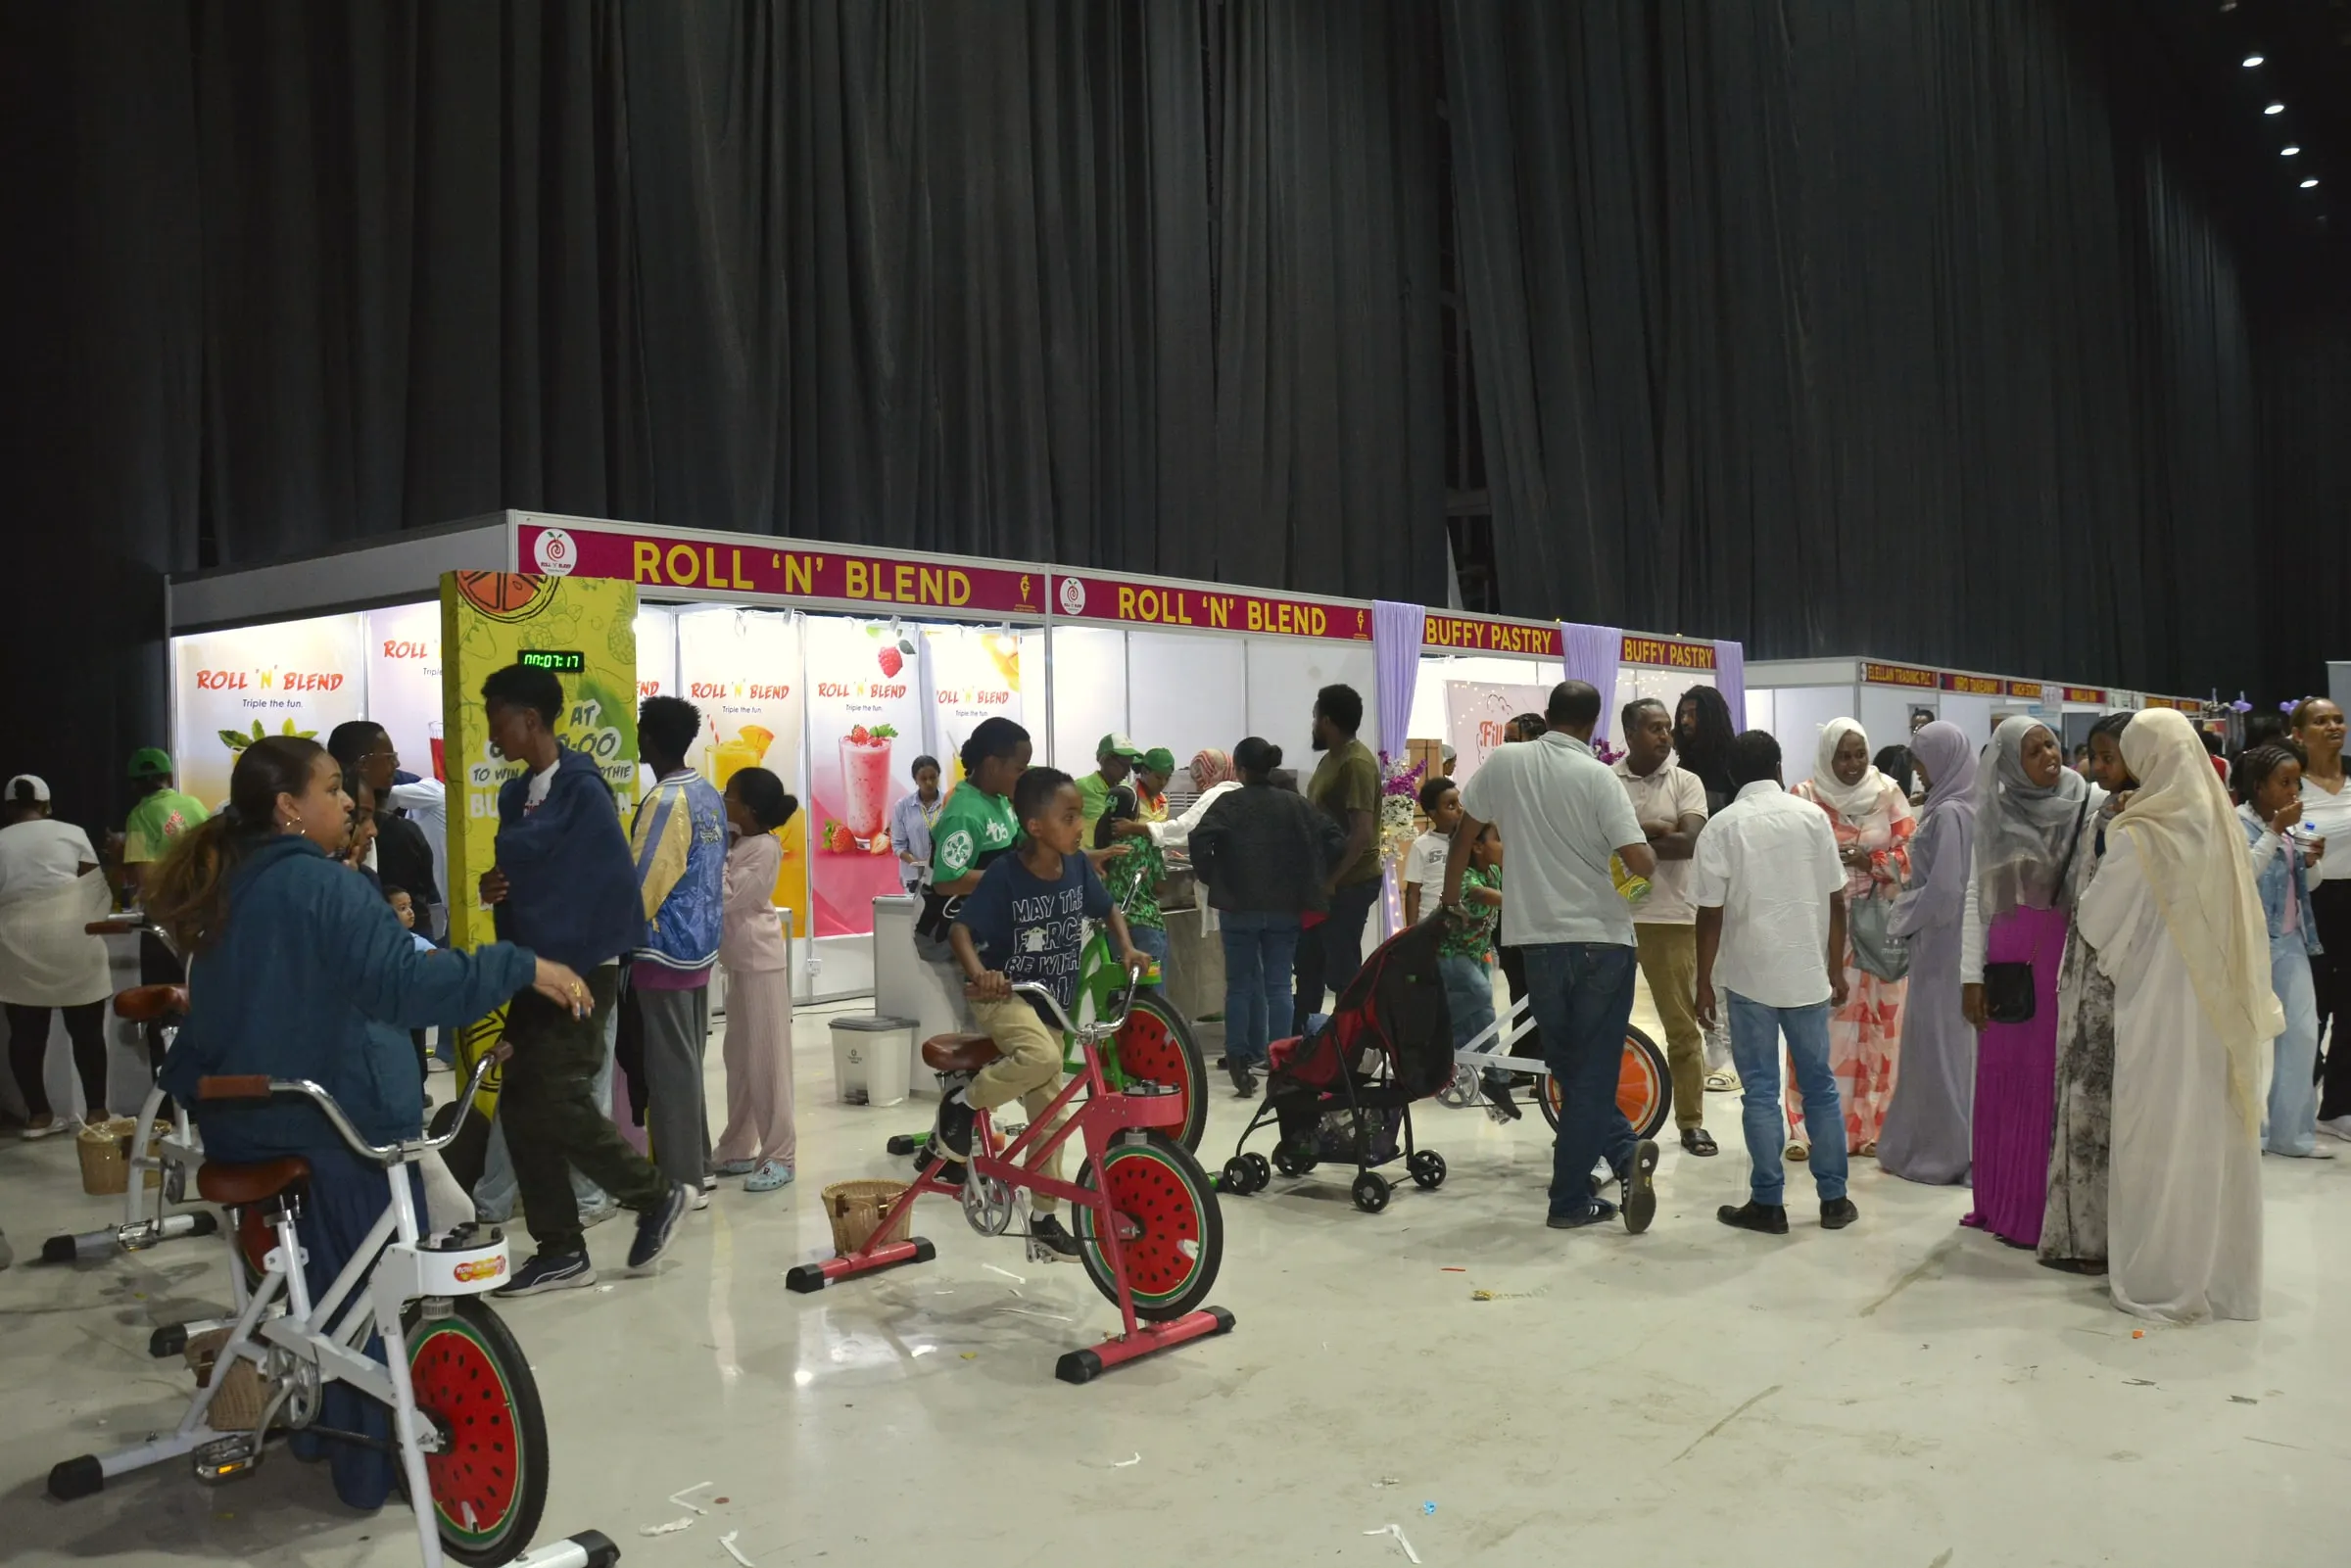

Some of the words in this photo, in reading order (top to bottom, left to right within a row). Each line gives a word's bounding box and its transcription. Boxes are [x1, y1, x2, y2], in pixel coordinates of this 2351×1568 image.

[634, 541, 754, 590] ROLL
[845, 560, 971, 606] BLEND
[1119, 588, 1192, 625] ROLL
[1247, 600, 1326, 636] BLEND
[1425, 617, 1485, 647] BUFFY
[1491, 625, 1552, 654] PASTRY
[383, 640, 428, 659] ROLL
[1624, 639, 1665, 662] BUFFY
[1669, 643, 1713, 668] PASTRY
[196, 670, 248, 689] ROLL
[283, 672, 344, 691] BLEND
[691, 683, 727, 698] ROLL
[749, 685, 790, 699] BLEND
[818, 683, 849, 697] ROLL
[870, 685, 907, 698] BLEND
[936, 689, 959, 704] OLL
[977, 689, 1009, 704] BLEND
[243, 698, 267, 709] Triple
[269, 698, 284, 707] the
[722, 705, 739, 714] Triple
[845, 703, 861, 712] Triple
[569, 704, 596, 727] AT
[473, 769, 490, 782] TO
[1012, 895, 1055, 923] MAY
